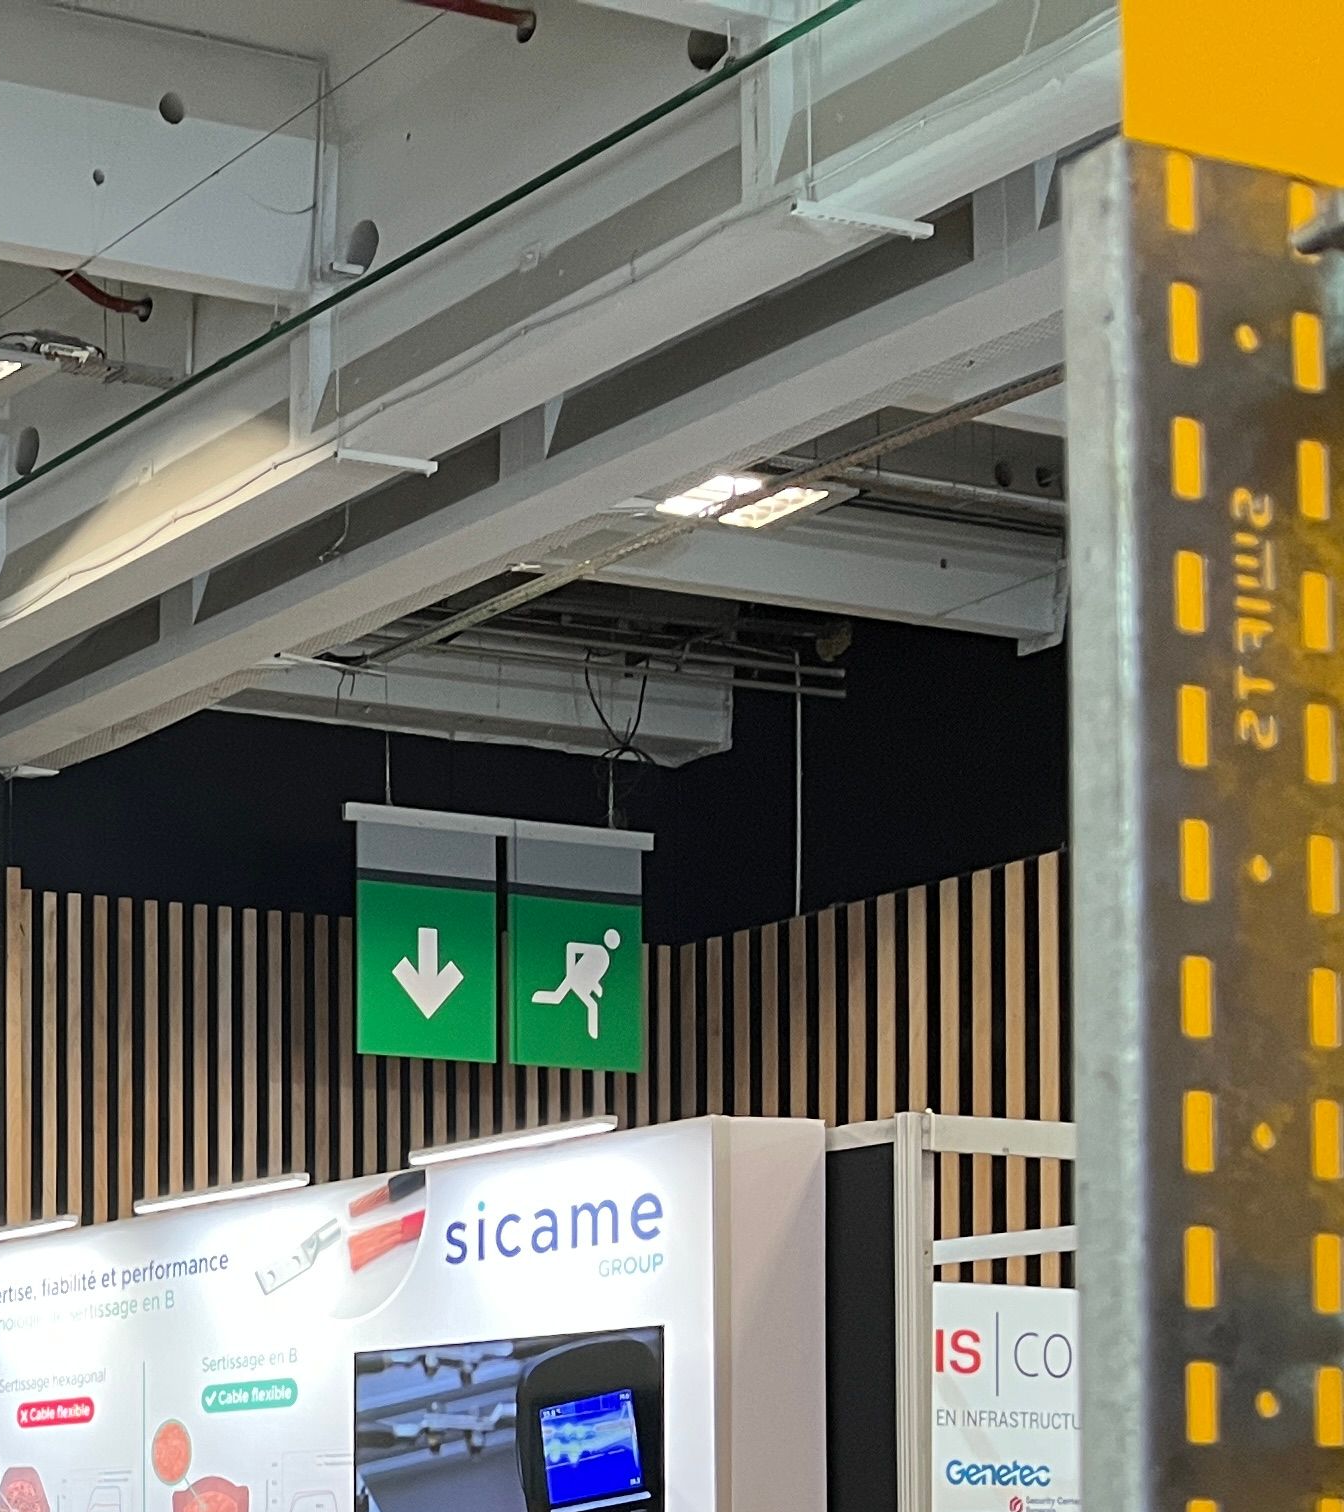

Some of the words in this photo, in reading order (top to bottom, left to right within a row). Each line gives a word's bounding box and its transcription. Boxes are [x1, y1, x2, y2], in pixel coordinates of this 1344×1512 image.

[445, 1192, 664, 1265] sicame
[42, 1269, 96, 1298] fiabilité
[101, 1269, 116, 1288] et
[121, 1253, 230, 1290] performance
[599, 1253, 664, 1277] GROUP
[143, 1294, 160, 1311] en
[165, 1290, 175, 1309] B
[202, 1354, 265, 1373] Sertissage
[269, 1351, 284, 1365] en
[289, 1347, 298, 1363] B
[1014, 1332, 1072, 1378] CO
[0, 1376, 50, 1393] Sertissage
[218, 1387, 249, 1405] Cable
[251, 1384, 292, 1402] flexible
[936, 1409, 956, 1426] EN
[946, 1459, 1051, 1487] Genetec
